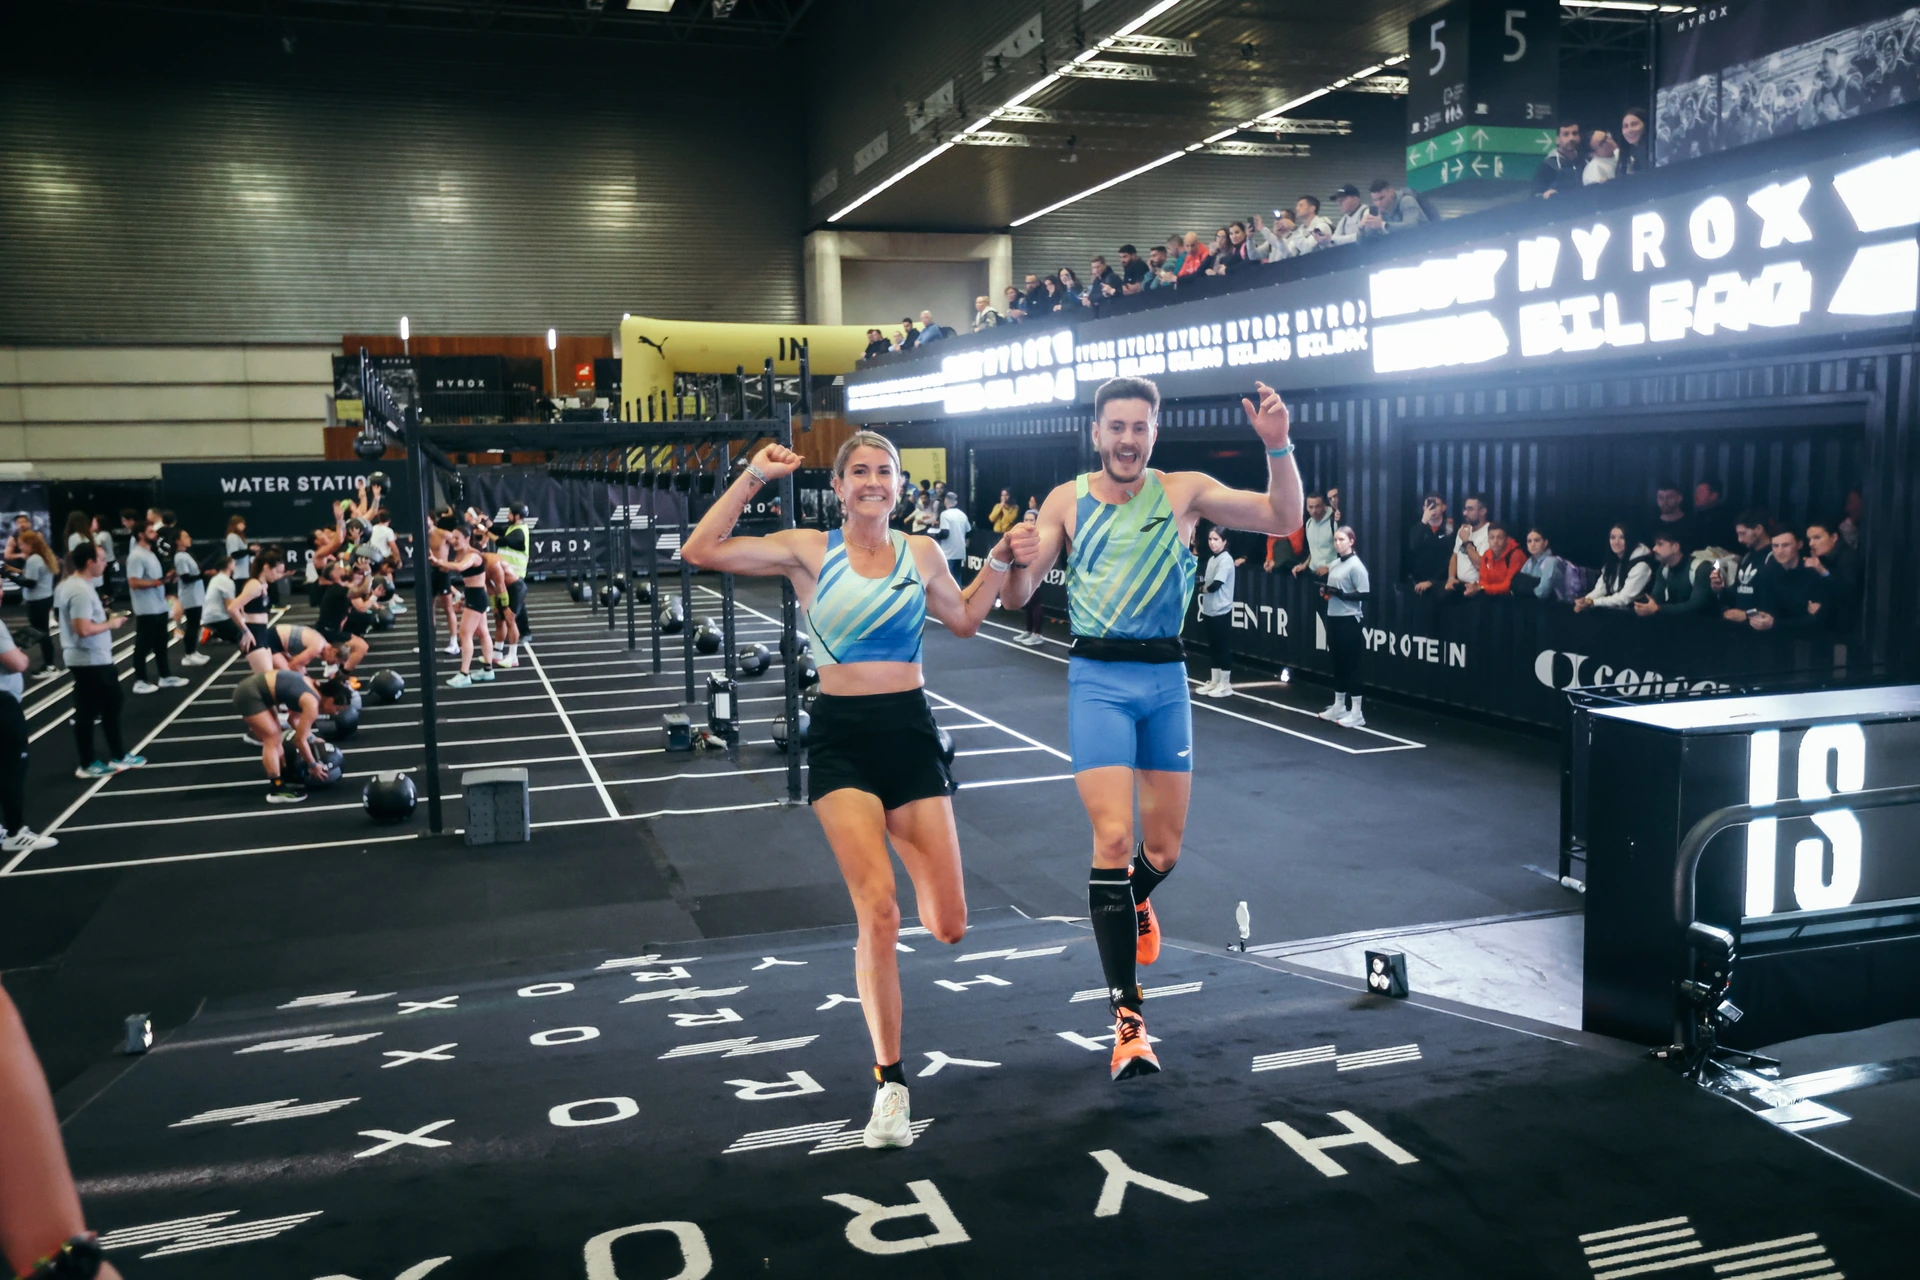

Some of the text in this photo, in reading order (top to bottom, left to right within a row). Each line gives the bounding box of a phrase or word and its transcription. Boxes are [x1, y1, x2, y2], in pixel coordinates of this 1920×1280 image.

[1503, 10, 1527, 62] 5
[1677, 5, 1728, 32] HYROX
[1429, 19, 1446, 76] 5
[1518, 176, 1812, 291] HYROX
[779, 337, 808, 361] IN
[436, 379, 485, 389] HYROX
[221, 475, 367, 493] WATER STATIO
[534, 539, 591, 554] YROX
[1231, 601, 1288, 637] ENTR
[1362, 627, 1466, 668] YPROTEIN
[1745, 722, 1866, 916] IS
